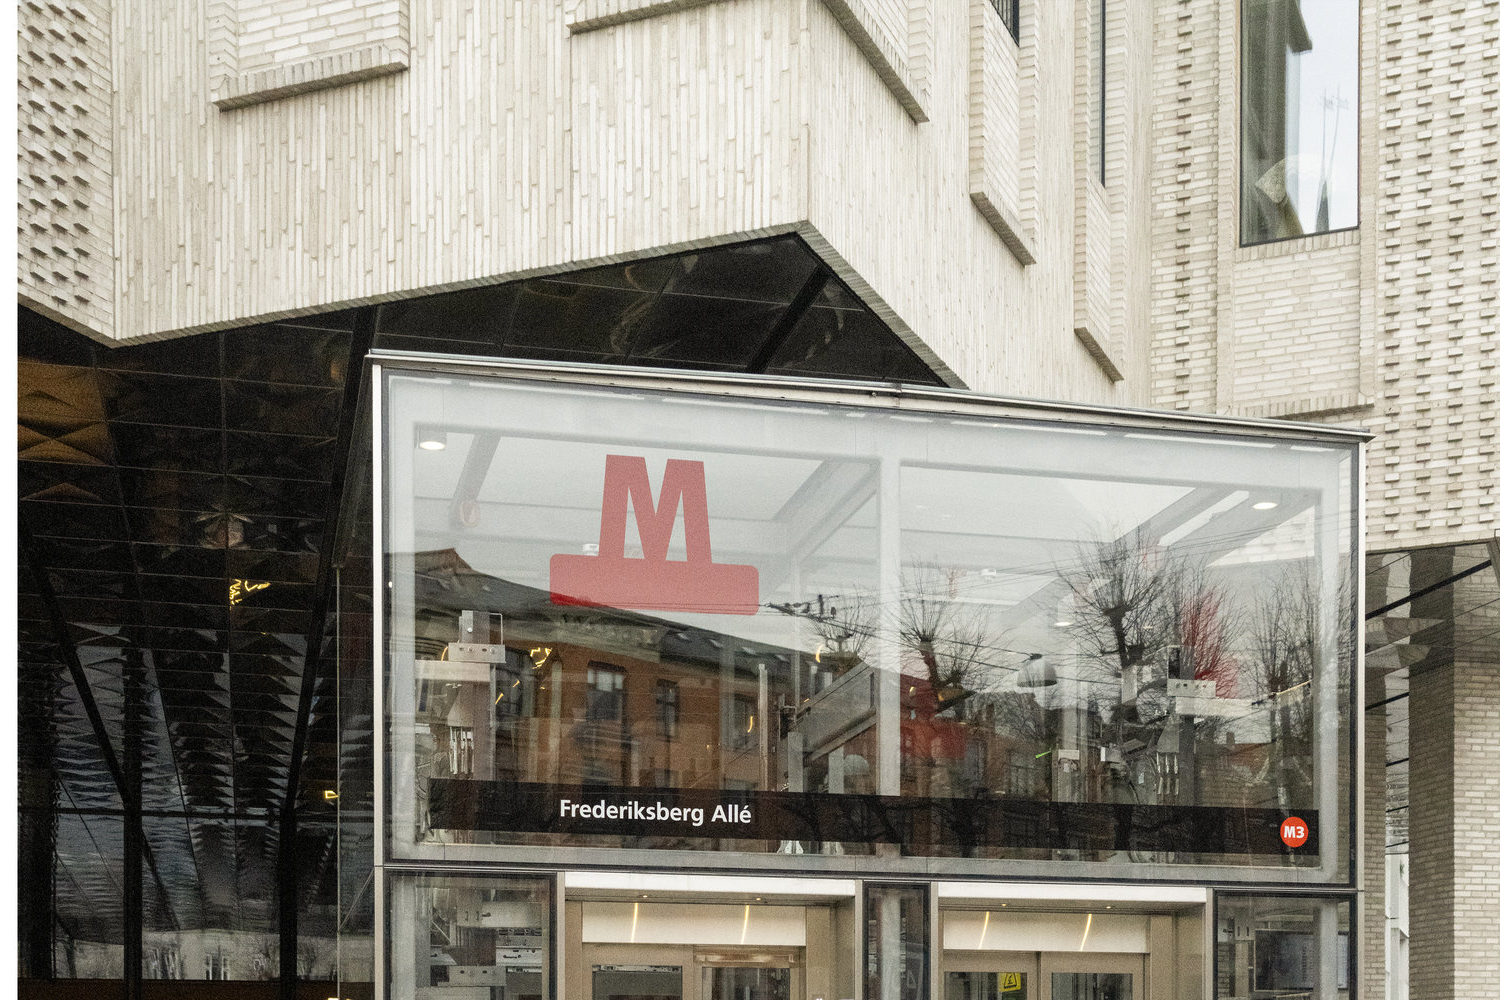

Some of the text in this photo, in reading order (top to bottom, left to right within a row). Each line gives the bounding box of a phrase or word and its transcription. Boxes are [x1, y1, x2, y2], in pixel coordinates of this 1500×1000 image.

[597, 454, 712, 563] M
[560, 799, 752, 827] Frederiksberg Allé
[1283, 825, 1305, 839] M3
